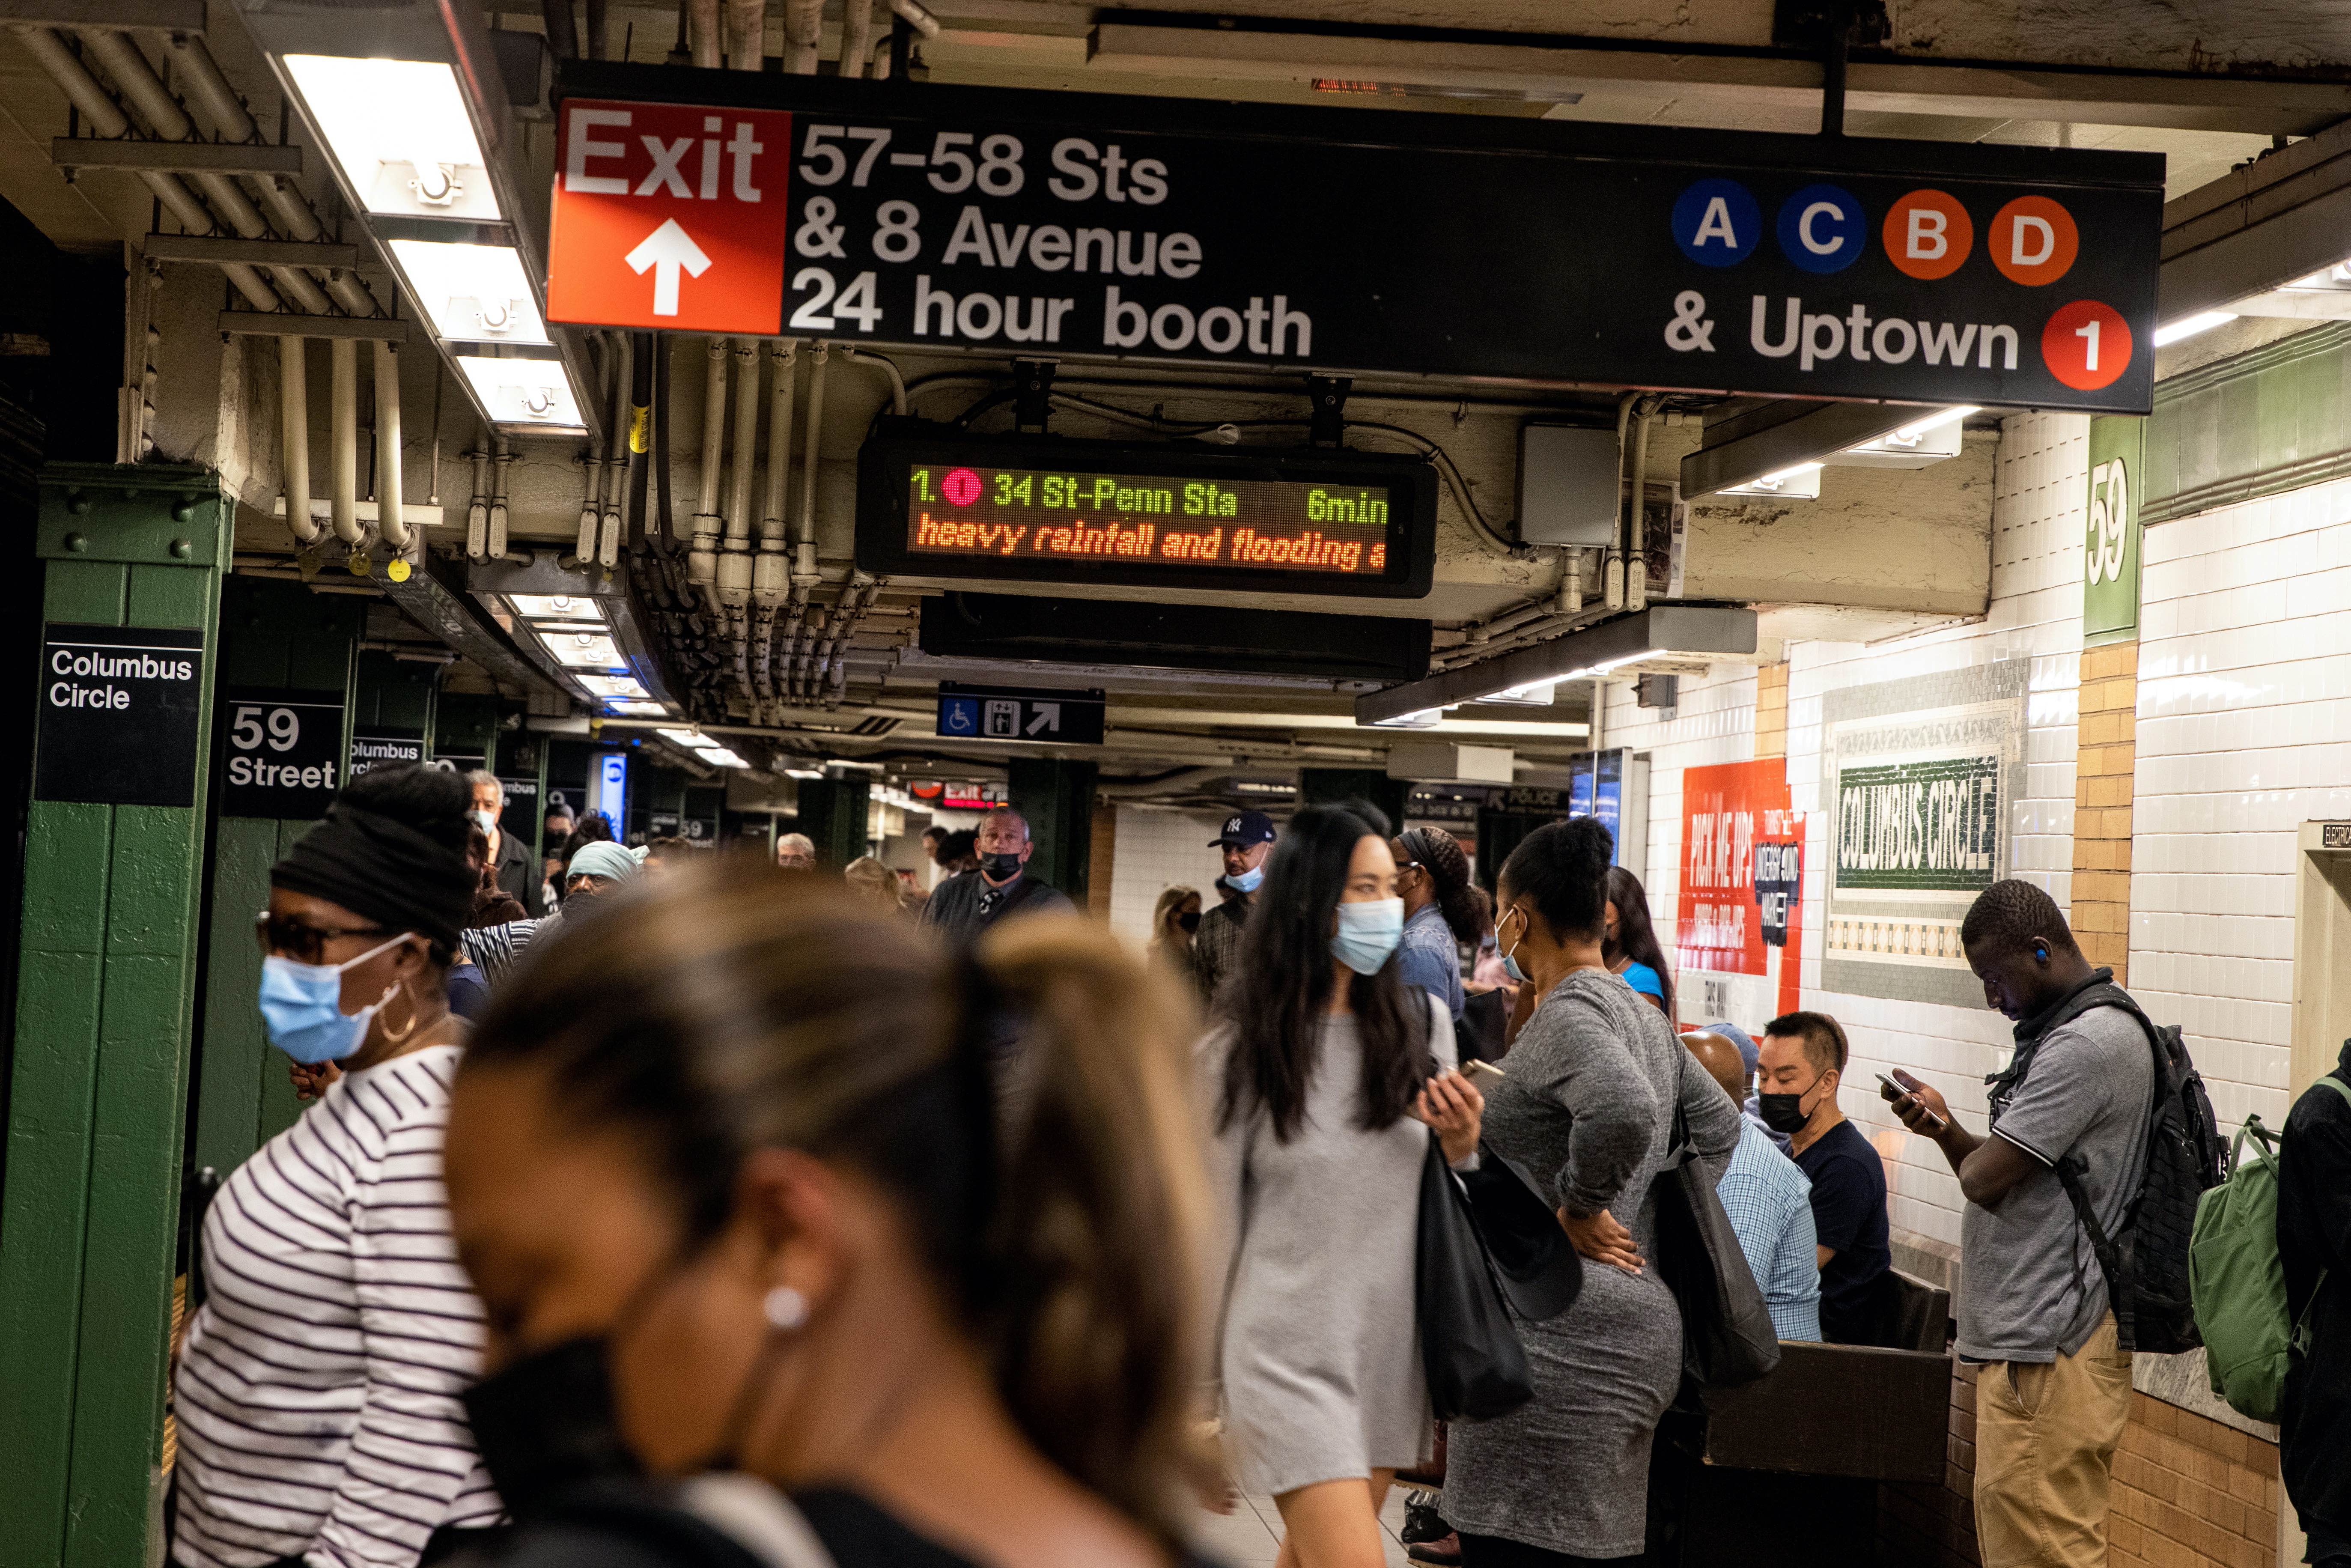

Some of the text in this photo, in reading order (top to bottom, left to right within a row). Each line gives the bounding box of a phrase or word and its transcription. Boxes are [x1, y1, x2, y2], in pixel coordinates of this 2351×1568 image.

[564, 108, 763, 203] Exit
[1048, 137, 1169, 206] Sts
[793, 196, 1203, 280] & 8 Avenue
[1692, 197, 2055, 266] A C B D
[789, 266, 1312, 358] 24 hour booth
[1664, 290, 2100, 372] & Uptown 1
[910, 470, 935, 501] 1.
[994, 474, 1031, 506] 34
[1043, 476, 1173, 515] St-Penn
[1183, 483, 1237, 518] Sta
[1307, 489, 1389, 524] 6min
[2088, 456, 2128, 586] 59
[917, 513, 1027, 556] heavy
[1034, 519, 1154, 557] rainfall
[1161, 527, 1222, 562] and
[1231, 528, 1362, 572] flooding
[49, 681, 130, 710] Circle
[51, 649, 192, 681] Columbus
[231, 706, 299, 752] 59
[351, 741, 418, 760] olumbus
[229, 755, 336, 790] Street
[1690, 811, 1754, 888] PICK ME UPS
[1841, 777, 1993, 870] COLUMBUS CIRCLE
[1761, 892, 1788, 927] MARKET
